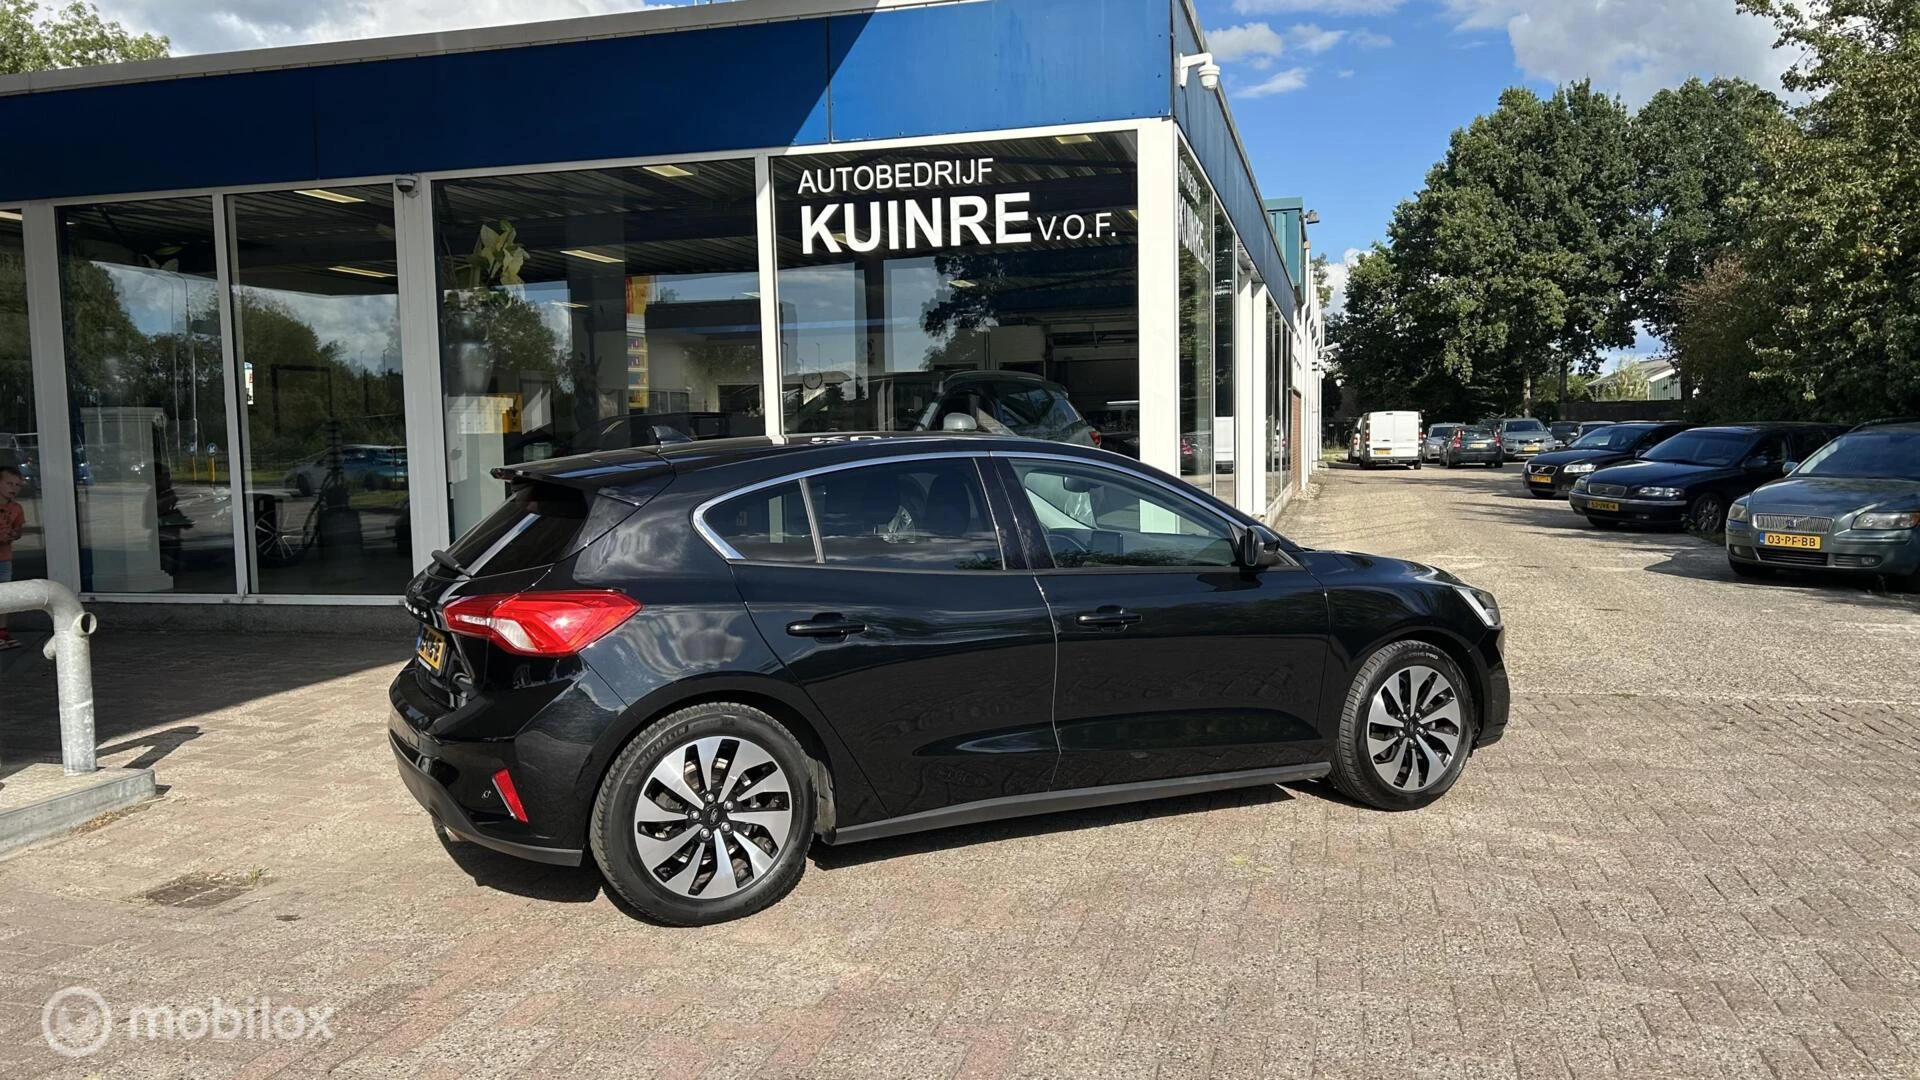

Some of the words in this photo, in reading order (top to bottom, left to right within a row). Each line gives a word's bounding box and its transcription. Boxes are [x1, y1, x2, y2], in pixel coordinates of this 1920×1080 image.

[797, 157, 995, 194] AUTOBEDRIJF
[800, 191, 1032, 255] KUINRE
[1036, 211, 1118, 242] V.O.F.
[1767, 534, 1816, 547] 03-PF-BB
